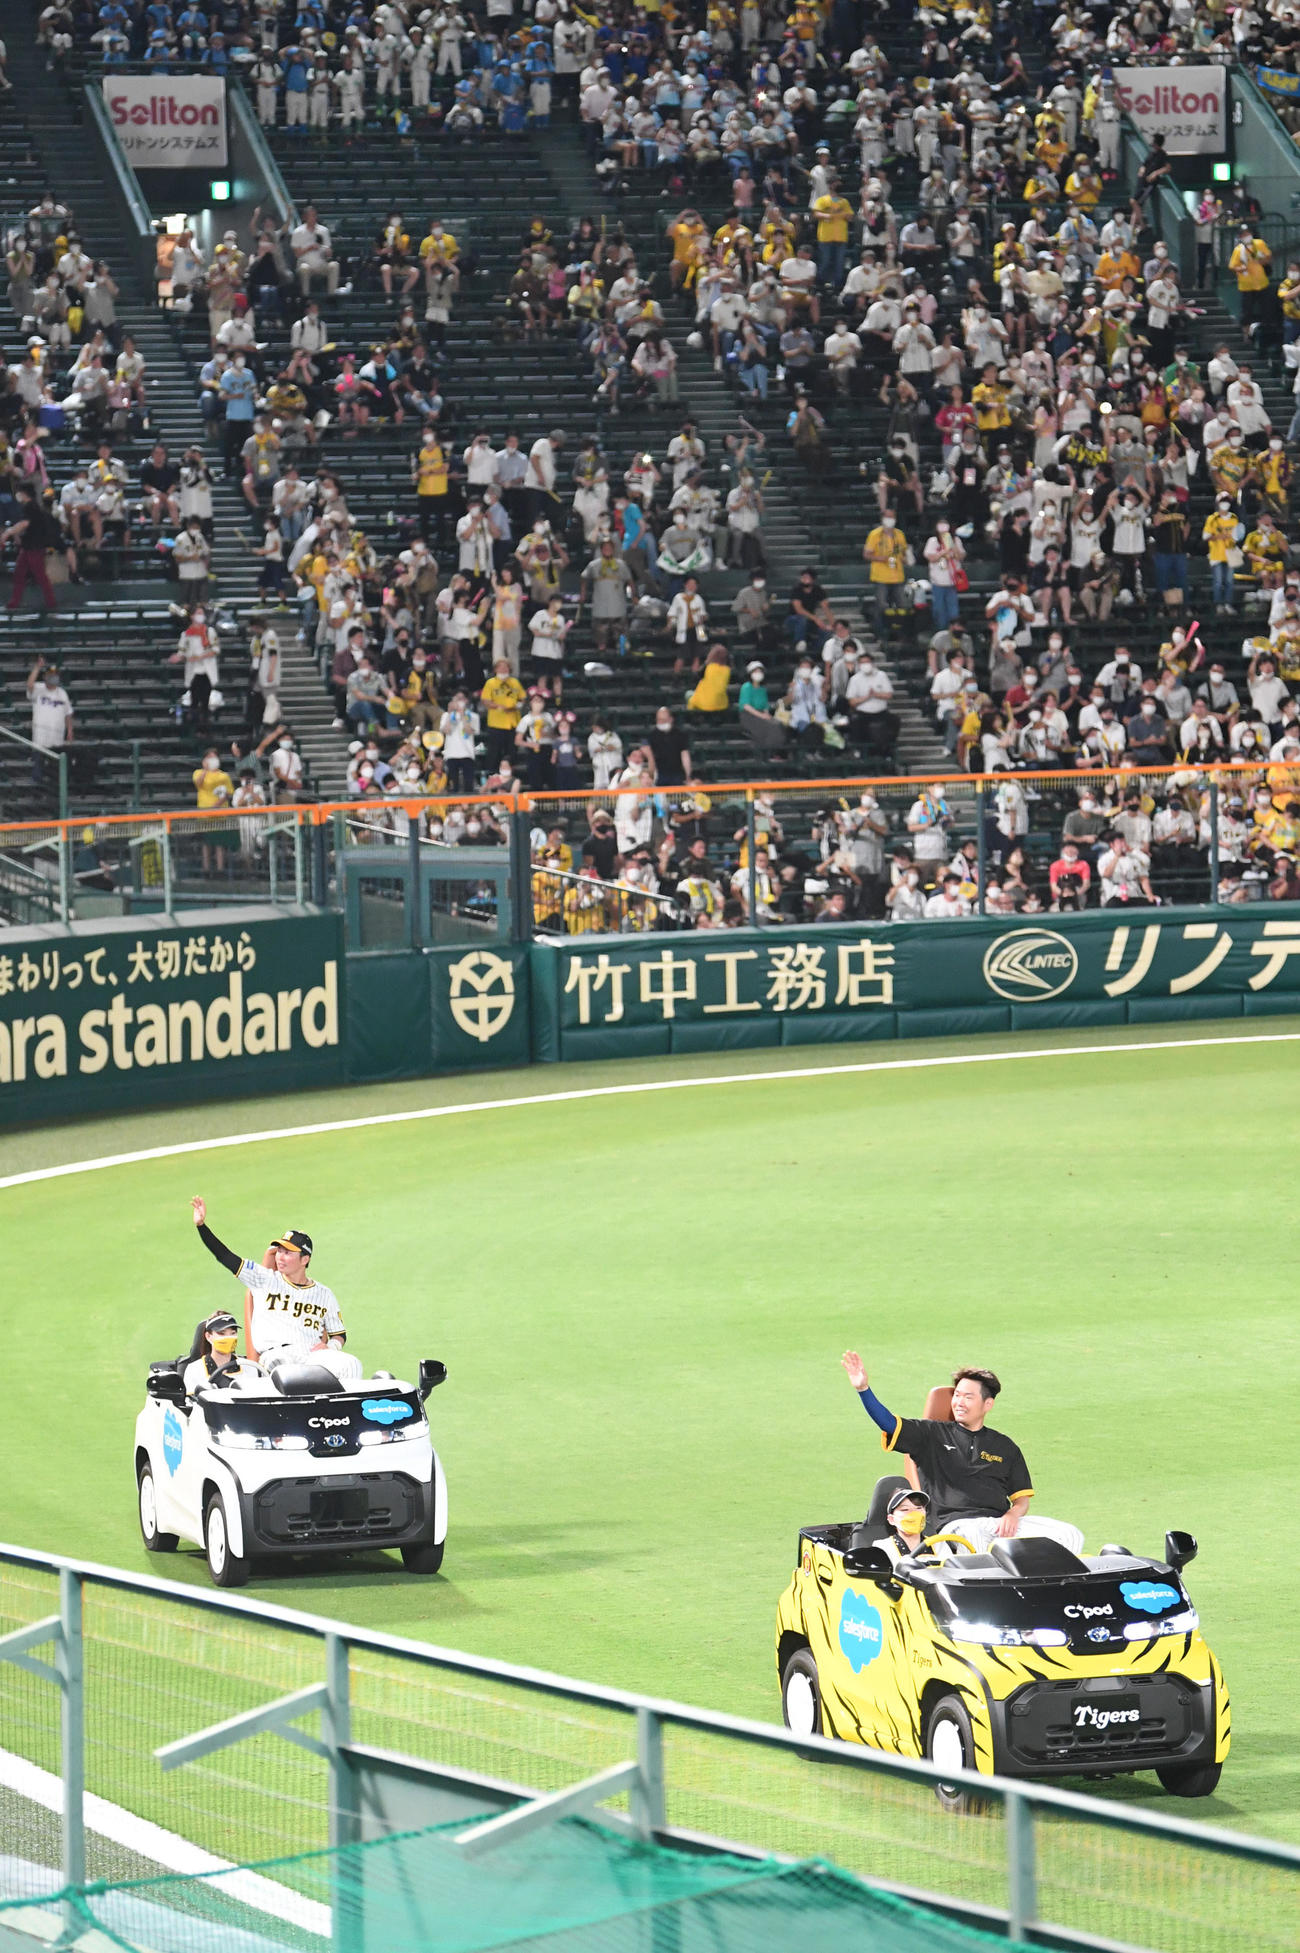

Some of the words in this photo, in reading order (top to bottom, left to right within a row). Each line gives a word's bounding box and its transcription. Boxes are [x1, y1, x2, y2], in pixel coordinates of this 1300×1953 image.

[110, 95, 218, 125] Soliton
[1117, 86, 1218, 114] Soliton
[121, 136, 218, 149] リトンシステムズ
[1025, 952, 1072, 969] LINTEC
[564, 939, 895, 1024] 竹中工務店
[79, 958, 338, 1074] standard
[265, 1292, 328, 1318] Tigers
[842, 1617, 879, 1642] salesforce
[1074, 1705, 1140, 1729] Tigers
